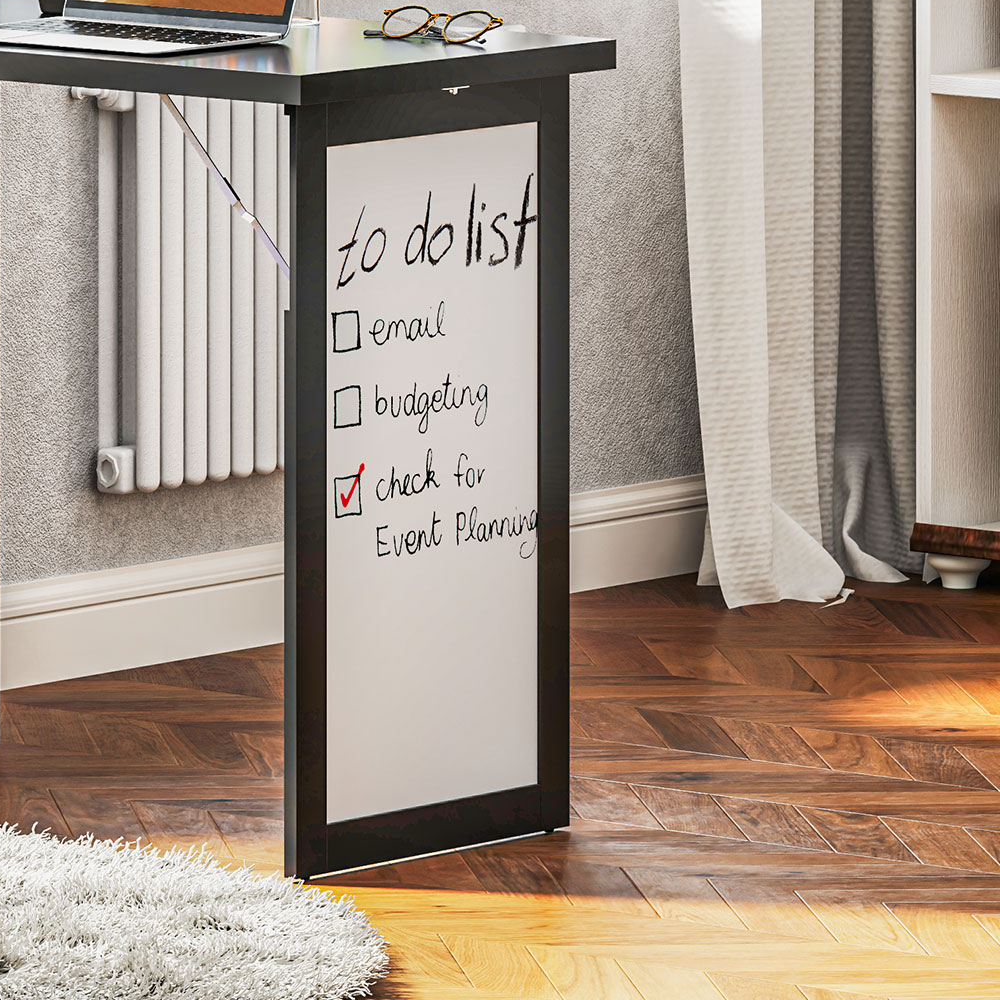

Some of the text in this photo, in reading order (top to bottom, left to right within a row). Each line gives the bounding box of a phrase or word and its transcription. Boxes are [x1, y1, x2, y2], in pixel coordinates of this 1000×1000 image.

[337, 173, 538, 289] to do list
[369, 301, 446, 345] email
[375, 373, 488, 434] budgeting
[376, 448, 485, 501] check for
[376, 506, 539, 559] Event Planning
